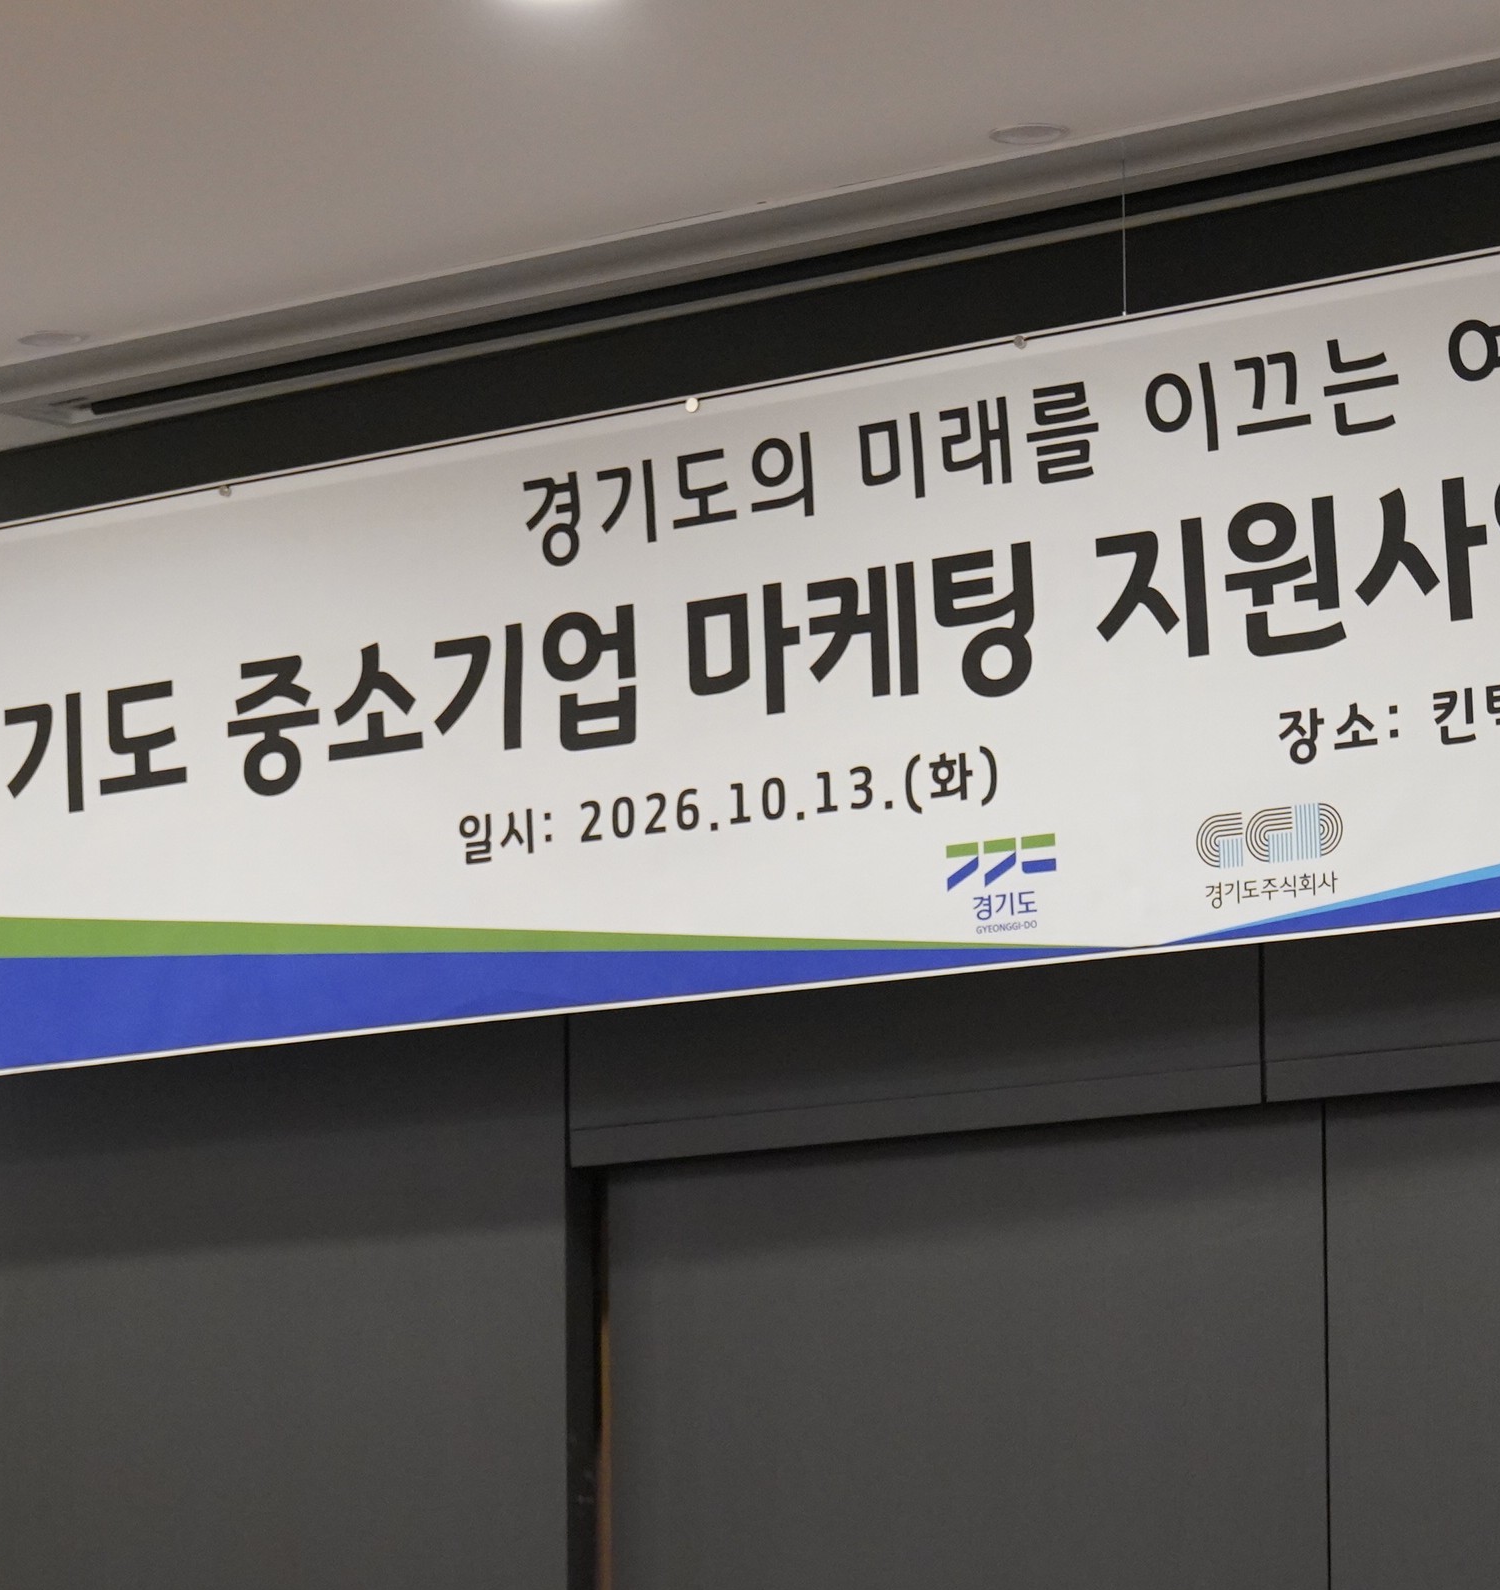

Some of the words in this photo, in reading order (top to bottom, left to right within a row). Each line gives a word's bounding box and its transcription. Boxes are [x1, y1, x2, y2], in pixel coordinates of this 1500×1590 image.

[522, 429, 816, 567] 경기도의
[857, 380, 1100, 499] 미래를
[1144, 338, 1401, 452] 이끄는
[227, 603, 638, 797] 중소기업
[686, 540, 1036, 716] 마케팅
[1278, 697, 1400, 765] 장소:
[458, 808, 553, 866] 일시:
[580, 745, 999, 843] 2026.10.13.(화)
[972, 890, 1038, 921] 경기도
[1204, 870, 1338, 910] 경기도주식회사
[975, 920, 1039, 935] GYEONGGI-DO
